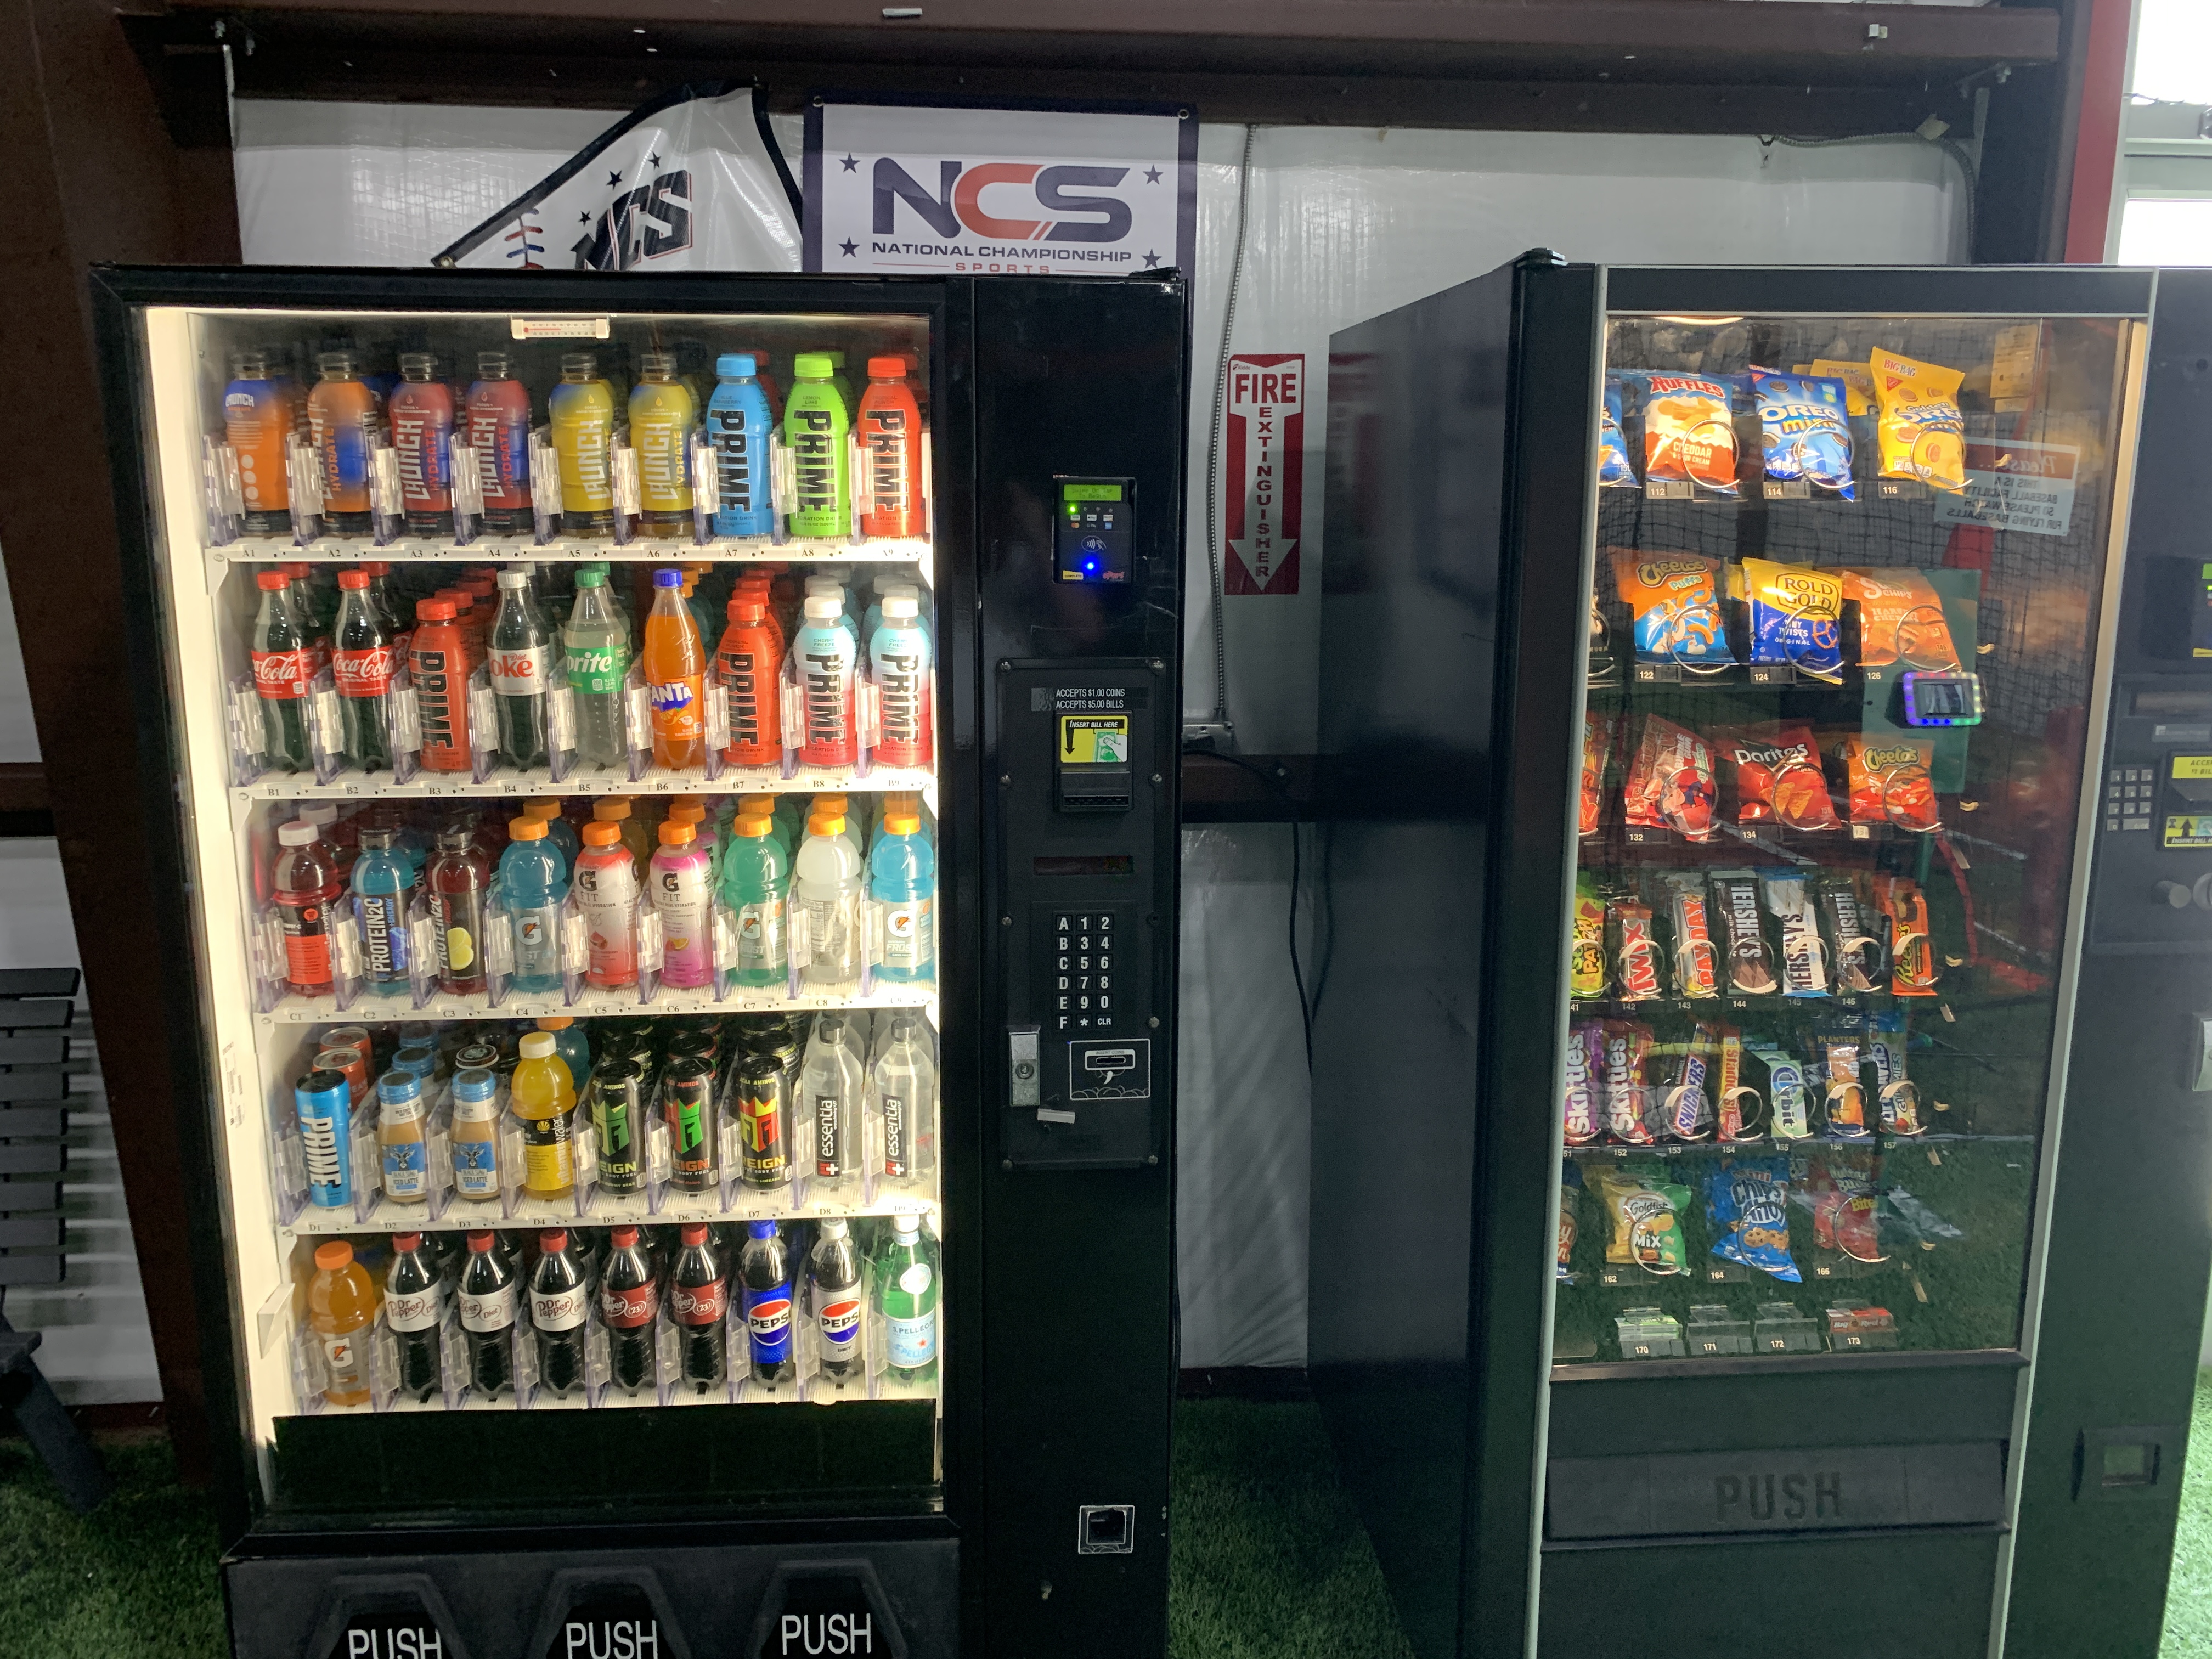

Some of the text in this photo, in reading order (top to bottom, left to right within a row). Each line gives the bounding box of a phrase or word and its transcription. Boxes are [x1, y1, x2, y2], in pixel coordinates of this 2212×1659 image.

[872, 157, 1132, 242] NCS
[872, 242, 1131, 262] NATIONAL CHAMPIONSHIP
[956, 262, 1049, 274] SPORTS
[1884, 359, 1916, 377] BIG BAG
[1235, 373, 1296, 403] FIRE
[1647, 376, 1725, 398] RUFFLES
[1758, 405, 1839, 422] OREO
[325, 427, 341, 492] HYDRATE
[425, 429, 439, 491] HYDRATE
[578, 420, 612, 500] LAUNCH
[643, 422, 678, 500] LAUNCH
[673, 430, 685, 490] HYDRATE
[710, 410, 752, 513] PRIME
[793, 410, 837, 513] PRIME
[866, 410, 910, 513] PRIME
[1692, 456, 1711, 465] CREAM
[1255, 407, 1273, 577] EXTINGUISHER
[328, 549, 341, 557] A2
[1637, 560, 1707, 587] Cheetos
[1669, 575, 1703, 591] Puffs
[1784, 578, 1833, 595] ROLD
[1882, 589, 1912, 599] CHIPS
[1788, 591, 1832, 609] GOLD
[333, 651, 393, 678] Coca-Cola
[410, 651, 454, 749] PRIME
[719, 653, 759, 745] PRIME
[805, 653, 847, 745] PRIME
[881, 653, 920, 745] PRIME
[1056, 688, 1125, 697] ACCEPTS $1.00 COINS
[1056, 699, 1124, 709] ACCEPTS $5.00 BILLS
[1070, 720, 1090, 728] INSERT
[1734, 743, 1808, 764] Doritos
[1864, 747, 1919, 771] Cheetos
[1629, 833, 1643, 842] 132
[579, 871, 597, 891] G
[662, 873, 680, 892] G
[580, 891, 598, 902] FIT
[663, 893, 680, 902] FIT
[515, 916, 543, 945] G
[741, 911, 761, 939] G
[1059, 917, 1109, 930] A 1 2
[1059, 936, 1109, 950] B 3 4
[1059, 956, 1109, 970] C 5 6
[1624, 922, 1657, 993] TWIX
[1059, 976, 1109, 989] D 7 8
[1060, 996, 1109, 1009] E 9 0
[1060, 1016, 1068, 1029] F
[1818, 1035, 1860, 1043] PLANTERS
[822, 1099, 833, 1157] essentia
[885, 1099, 898, 1156] essentia
[301, 1116, 341, 1188] PRIME
[388, 1301, 421, 1317] Pepper
[397, 1300, 410, 1310] Dr
[483, 1307, 498, 1319] Diet
[536, 1300, 570, 1317] Pepper
[546, 1299, 560, 1308] Dr
[630, 1306, 640, 1314] 23
[699, 1303, 708, 1312] 23
[1703, 1342, 1716, 1351] 171
[1770, 1340, 1784, 1348] 172
[1847, 1337, 1860, 1345] 173
[324, 1338, 353, 1368] G
[1714, 1471, 1842, 1522] PUSH
[348, 1628, 442, 1659] PUSH
[566, 1620, 658, 1659] PUSH
[782, 1613, 871, 1656] PUSH
